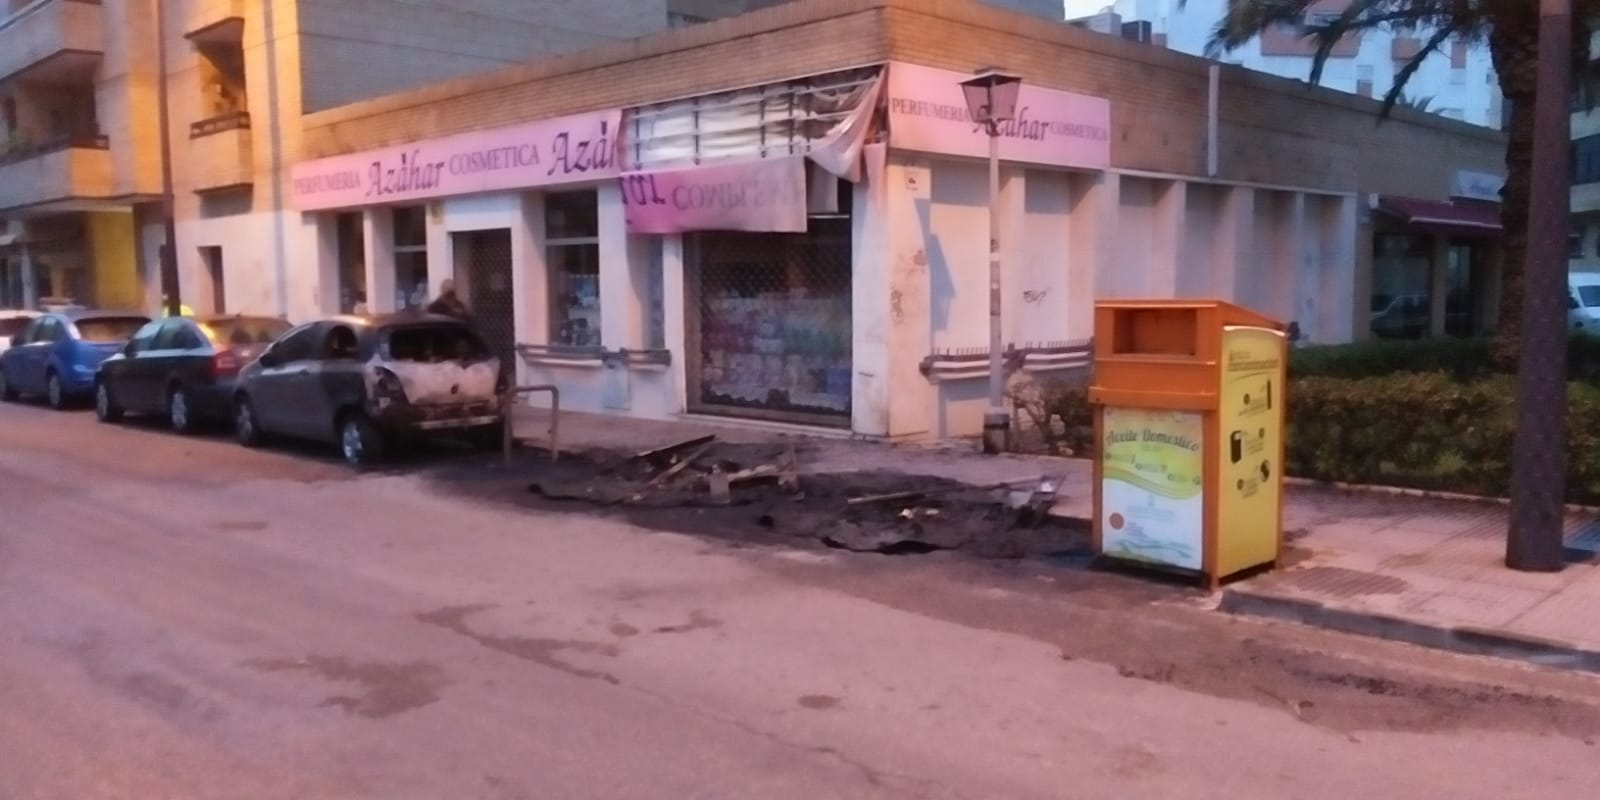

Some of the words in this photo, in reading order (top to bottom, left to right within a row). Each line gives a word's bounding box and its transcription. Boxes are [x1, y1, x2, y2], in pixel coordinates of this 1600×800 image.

[891, 97, 971, 122] PERFUMERIA
[1050, 120, 1107, 141] COSMETICA
[294, 170, 361, 195] PERFUMERIA
[449, 143, 539, 176] COSMETICA
